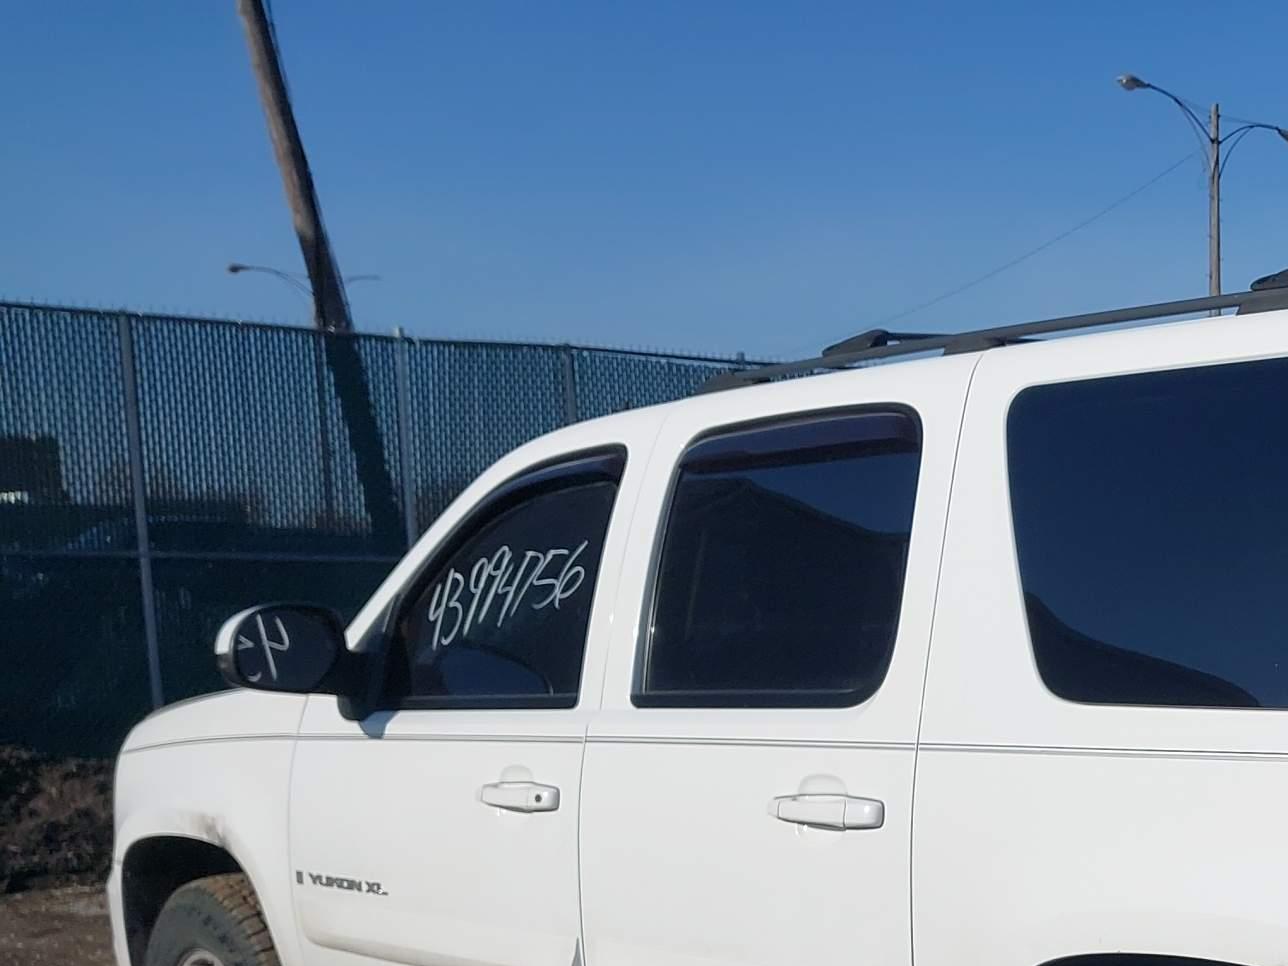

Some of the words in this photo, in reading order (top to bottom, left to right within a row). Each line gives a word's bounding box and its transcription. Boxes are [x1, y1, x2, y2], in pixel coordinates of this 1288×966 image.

[428, 540, 588, 651] 43994756
[308, 871, 363, 892] YUKON
[365, 880, 389, 896] XL
